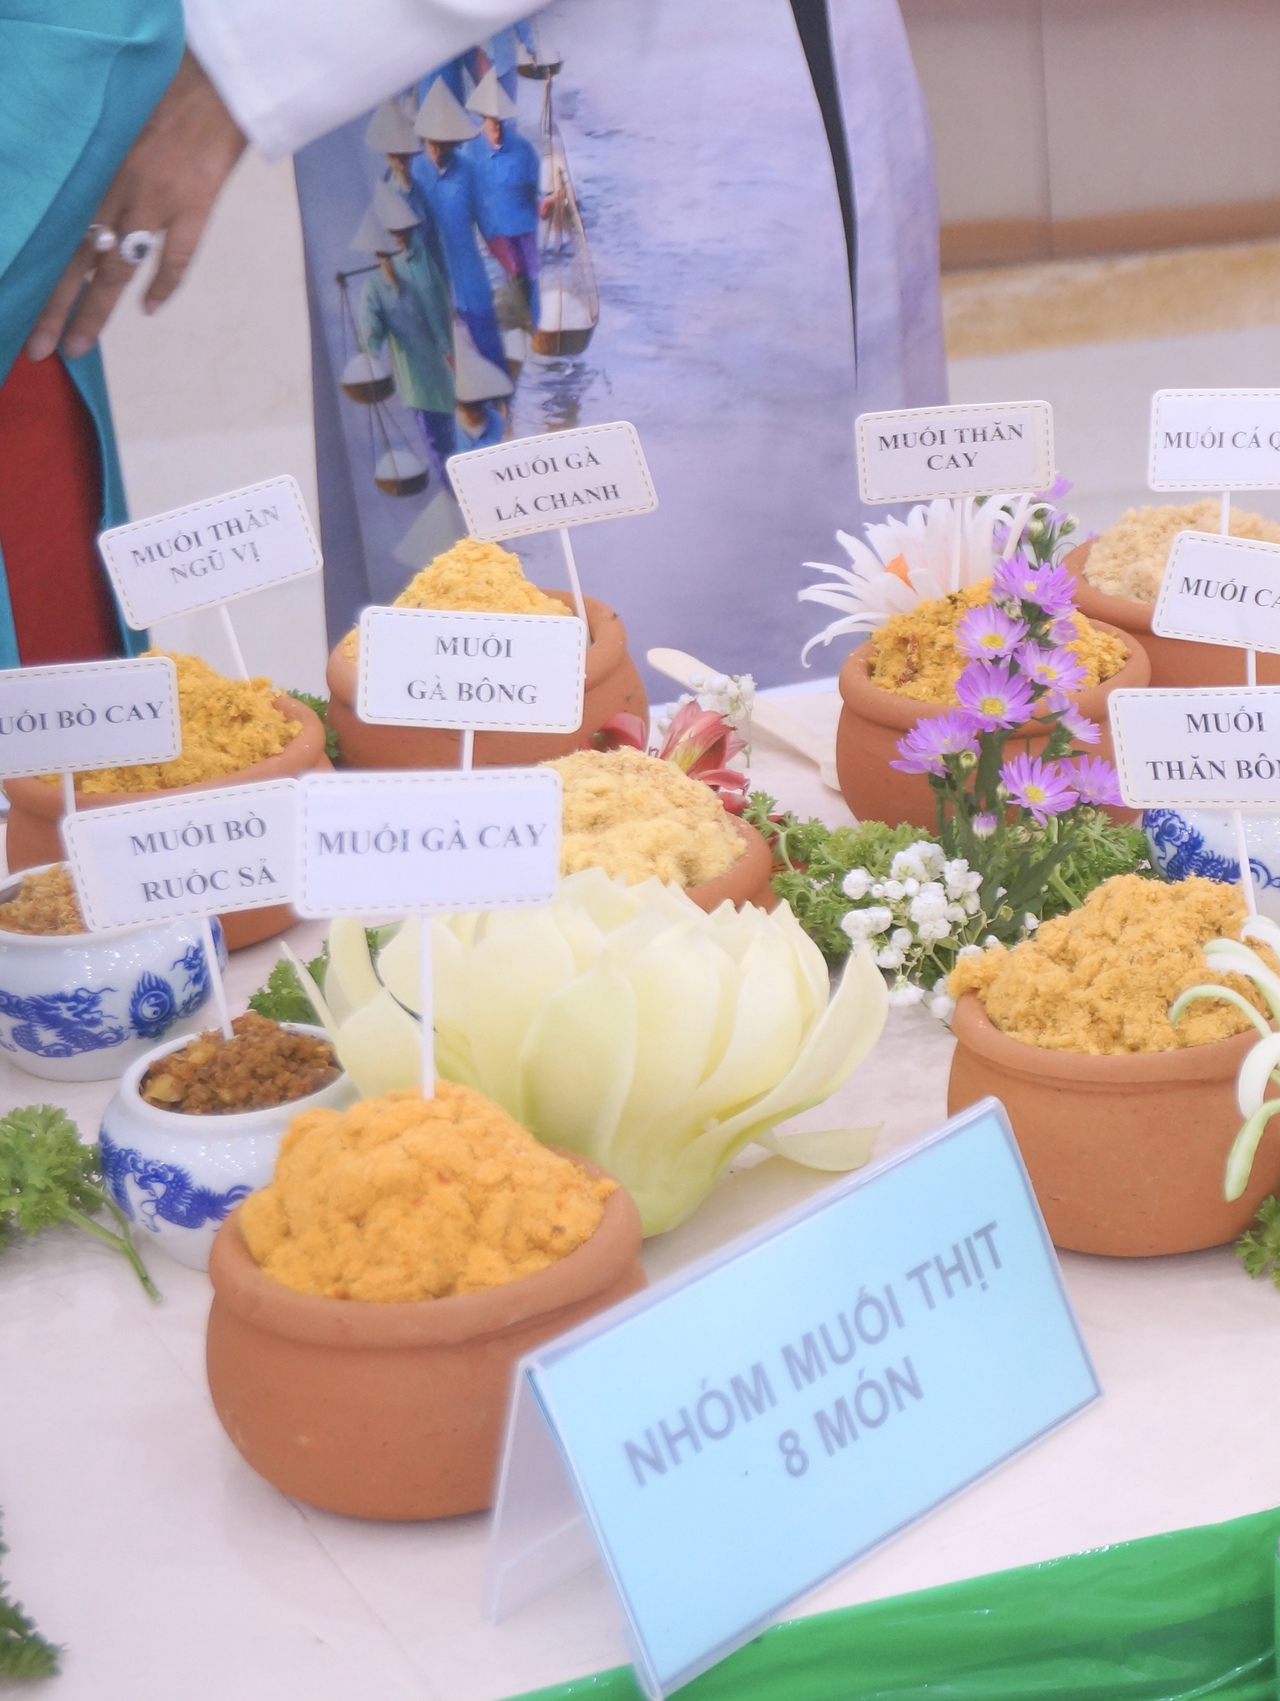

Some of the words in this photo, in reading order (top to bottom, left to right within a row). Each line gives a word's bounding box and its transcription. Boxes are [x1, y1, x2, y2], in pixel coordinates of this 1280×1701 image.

[878, 426, 946, 452] MUỐI
[954, 421, 1024, 445] THĂN
[1164, 426, 1225, 449] MUỐI
[1232, 426, 1262, 449] CÁ
[491, 455, 560, 485] MUỐI
[565, 446, 601, 470] GÀ
[927, 451, 978, 471] CAY
[495, 496, 529, 521] LÁ
[534, 484, 621, 512] CHANH
[131, 530, 204, 567] MUỐI
[207, 506, 281, 542] THĂN
[170, 549, 225, 584] NGŨ
[231, 541, 261, 563] VỊ
[1179, 576, 1250, 604] MUỐI
[435, 632, 514, 658] MUỐI
[407, 674, 447, 701] GÀ
[457, 676, 538, 705] BÔNG
[57, 702, 97, 730] BÒ
[105, 701, 164, 724] CAY
[1184, 705, 1267, 734] MUỐI
[1146, 754, 1227, 781] THĂN
[130, 820, 218, 856] MUỐI
[224, 811, 267, 842] BÒ
[318, 822, 411, 856] MUỐI
[421, 819, 469, 852] GÀ
[478, 823, 547, 850] CAY
[141, 868, 231, 903] RUỐC
[238, 857, 278, 888] SẢ
[622, 1361, 778, 1488] NHÓM
[780, 1284, 907, 1392] MUỐI
[905, 1220, 1003, 1311] THỊT
[777, 1428, 811, 1479] 8
[812, 1355, 925, 1457] MÓN
